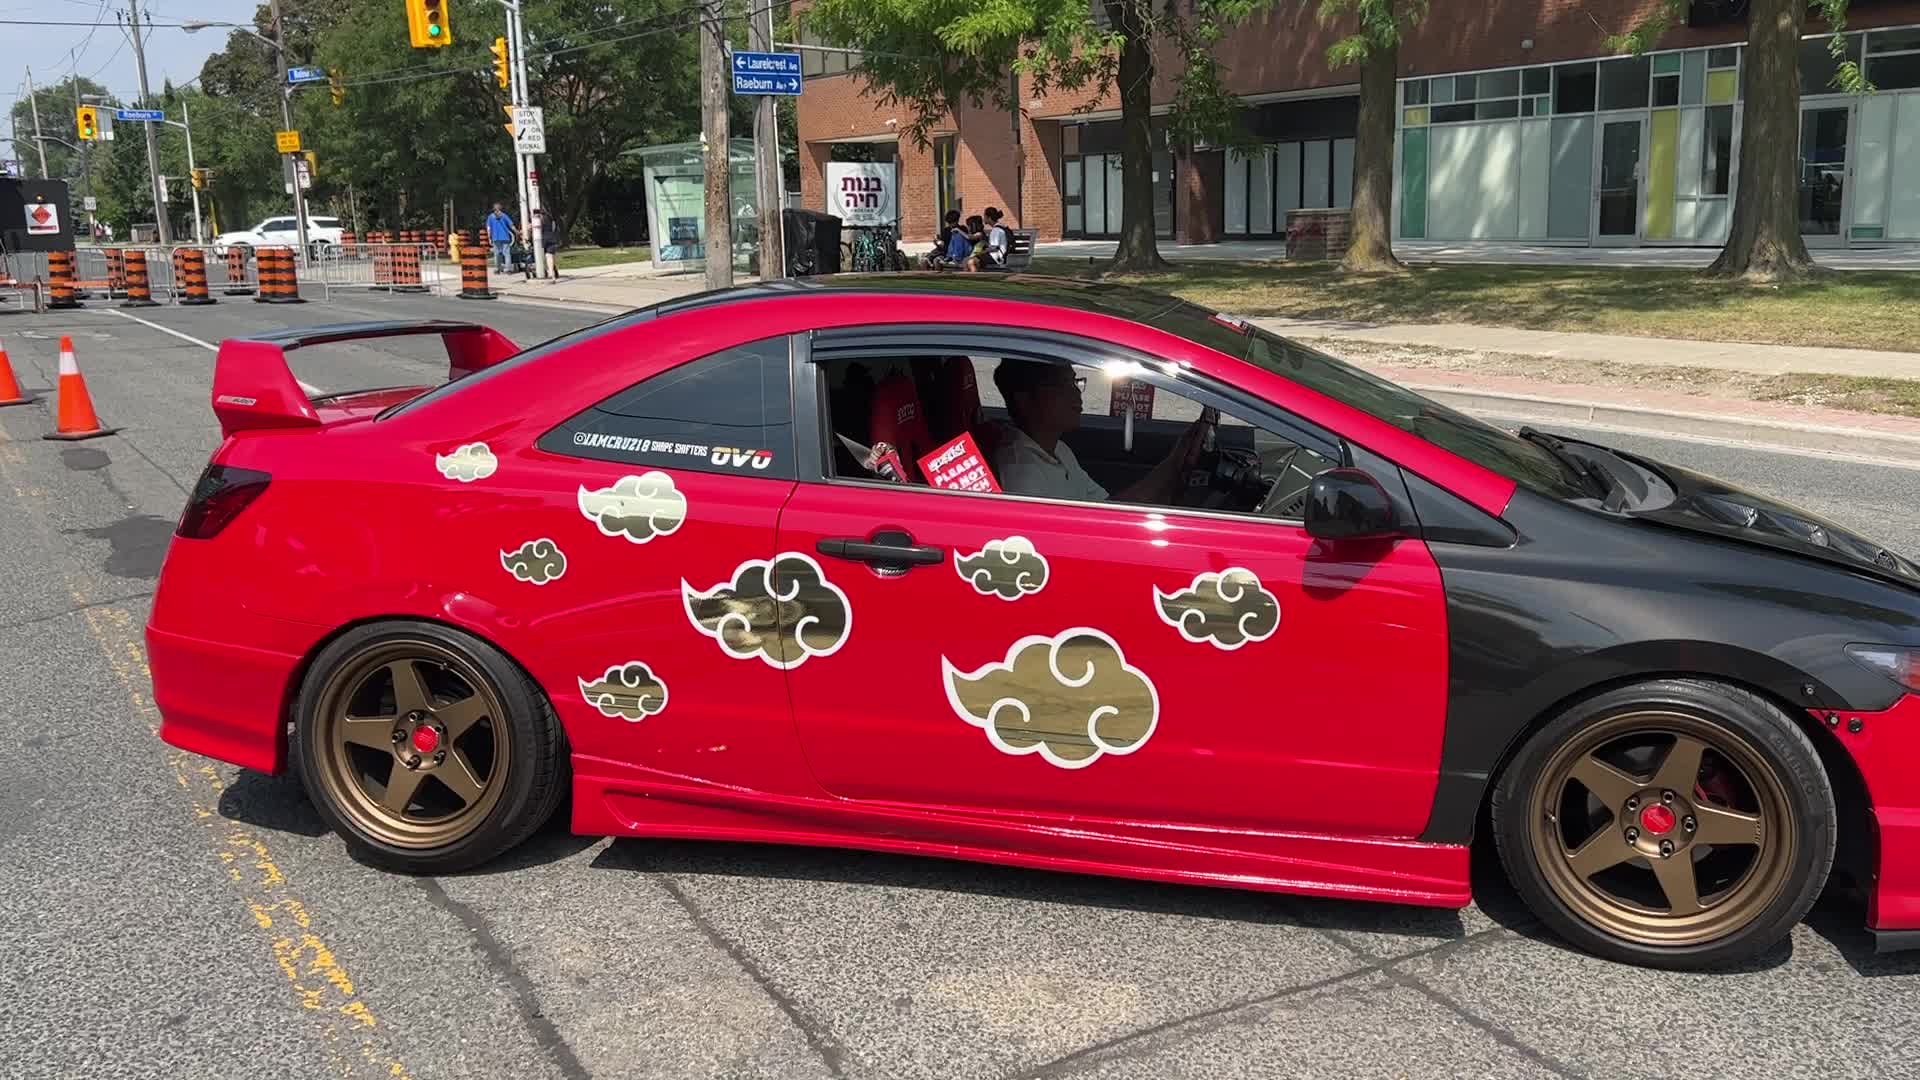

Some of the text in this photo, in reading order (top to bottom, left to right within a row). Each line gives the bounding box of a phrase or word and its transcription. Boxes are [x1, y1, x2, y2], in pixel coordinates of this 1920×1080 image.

[747, 56, 798, 71] Laurelcrest Ave
[736, 76, 773, 89] Raeburn
[841, 176, 883, 192] בנות
[846, 193, 878, 208] חיה
[651, 440, 674, 453] SHAPE
[674, 443, 708, 457] SHIFTERS
[710, 446, 774, 469] OVO
[934, 455, 980, 487] PLEASE
[959, 466, 988, 489] NOT
